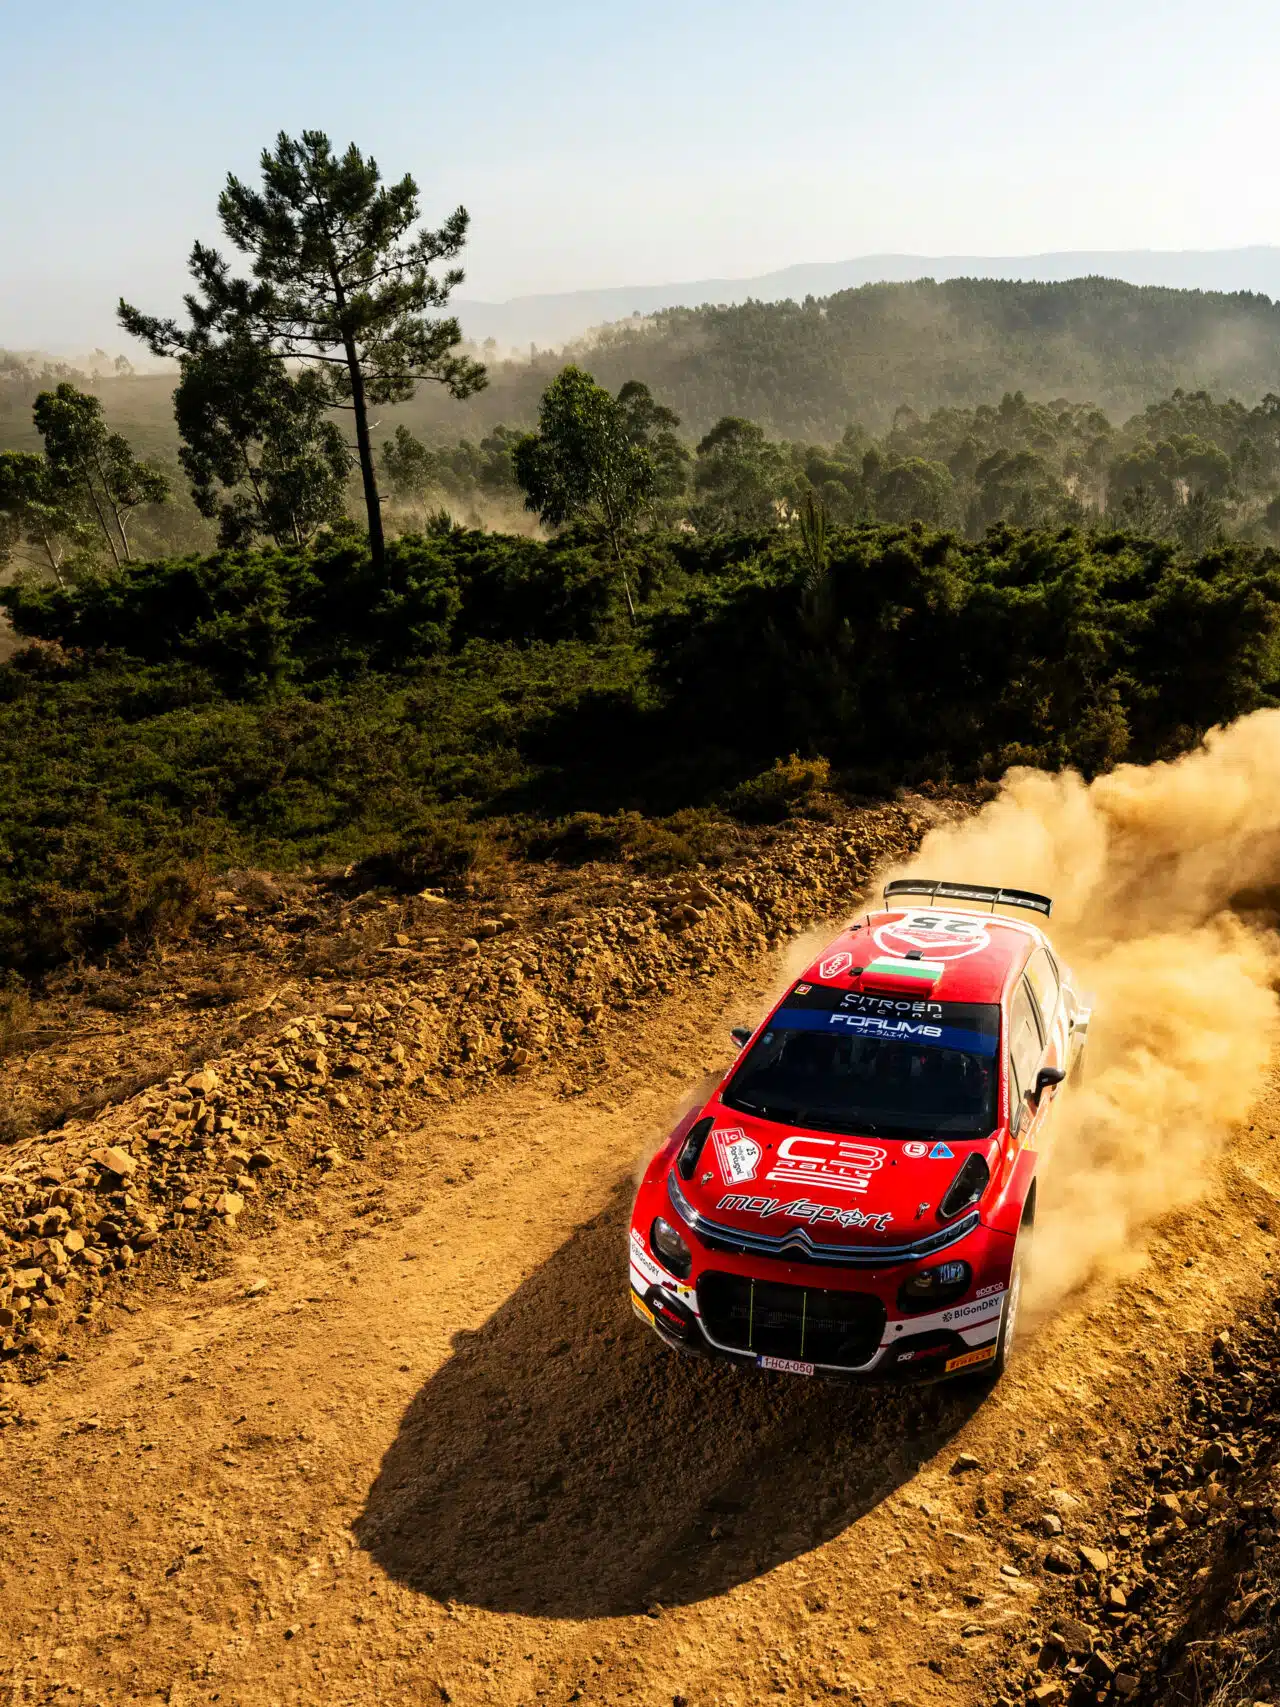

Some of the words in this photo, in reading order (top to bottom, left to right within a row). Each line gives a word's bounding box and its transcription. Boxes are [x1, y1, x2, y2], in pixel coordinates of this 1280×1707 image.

[908, 916, 978, 935] 25
[840, 1001, 942, 1019] RACING
[829, 1013, 942, 1038] FORUM8
[856, 1027, 910, 1040] フォーラムエイト
[746, 1147, 757, 1156] 25
[777, 1136, 887, 1171] C3
[730, 1146, 744, 1176] Portugal
[976, 1282, 1004, 1298] sparco
[954, 1297, 999, 1319] BIGonDRY
[764, 1357, 813, 1375] 1-HCA-050
